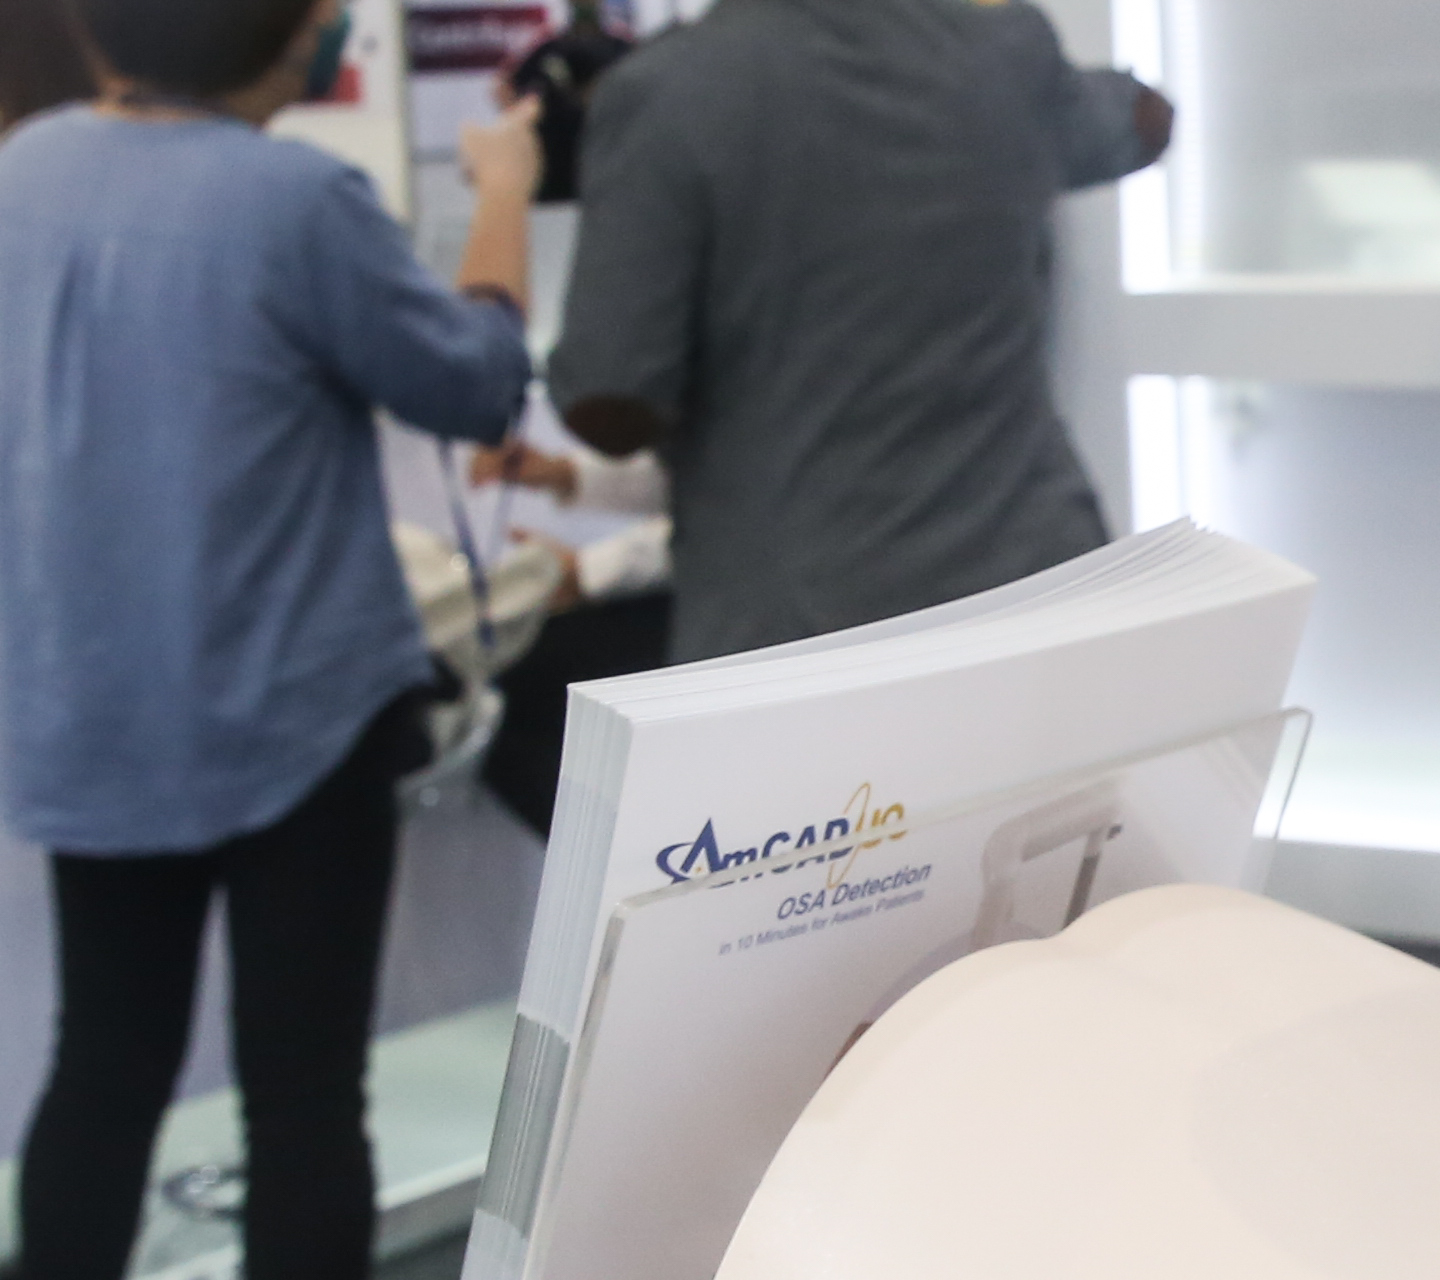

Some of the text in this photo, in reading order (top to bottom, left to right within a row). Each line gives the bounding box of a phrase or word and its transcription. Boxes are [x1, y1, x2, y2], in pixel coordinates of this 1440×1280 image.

[777, 864, 932, 920] OSA Detection
[756, 922, 808, 946] Minutes
